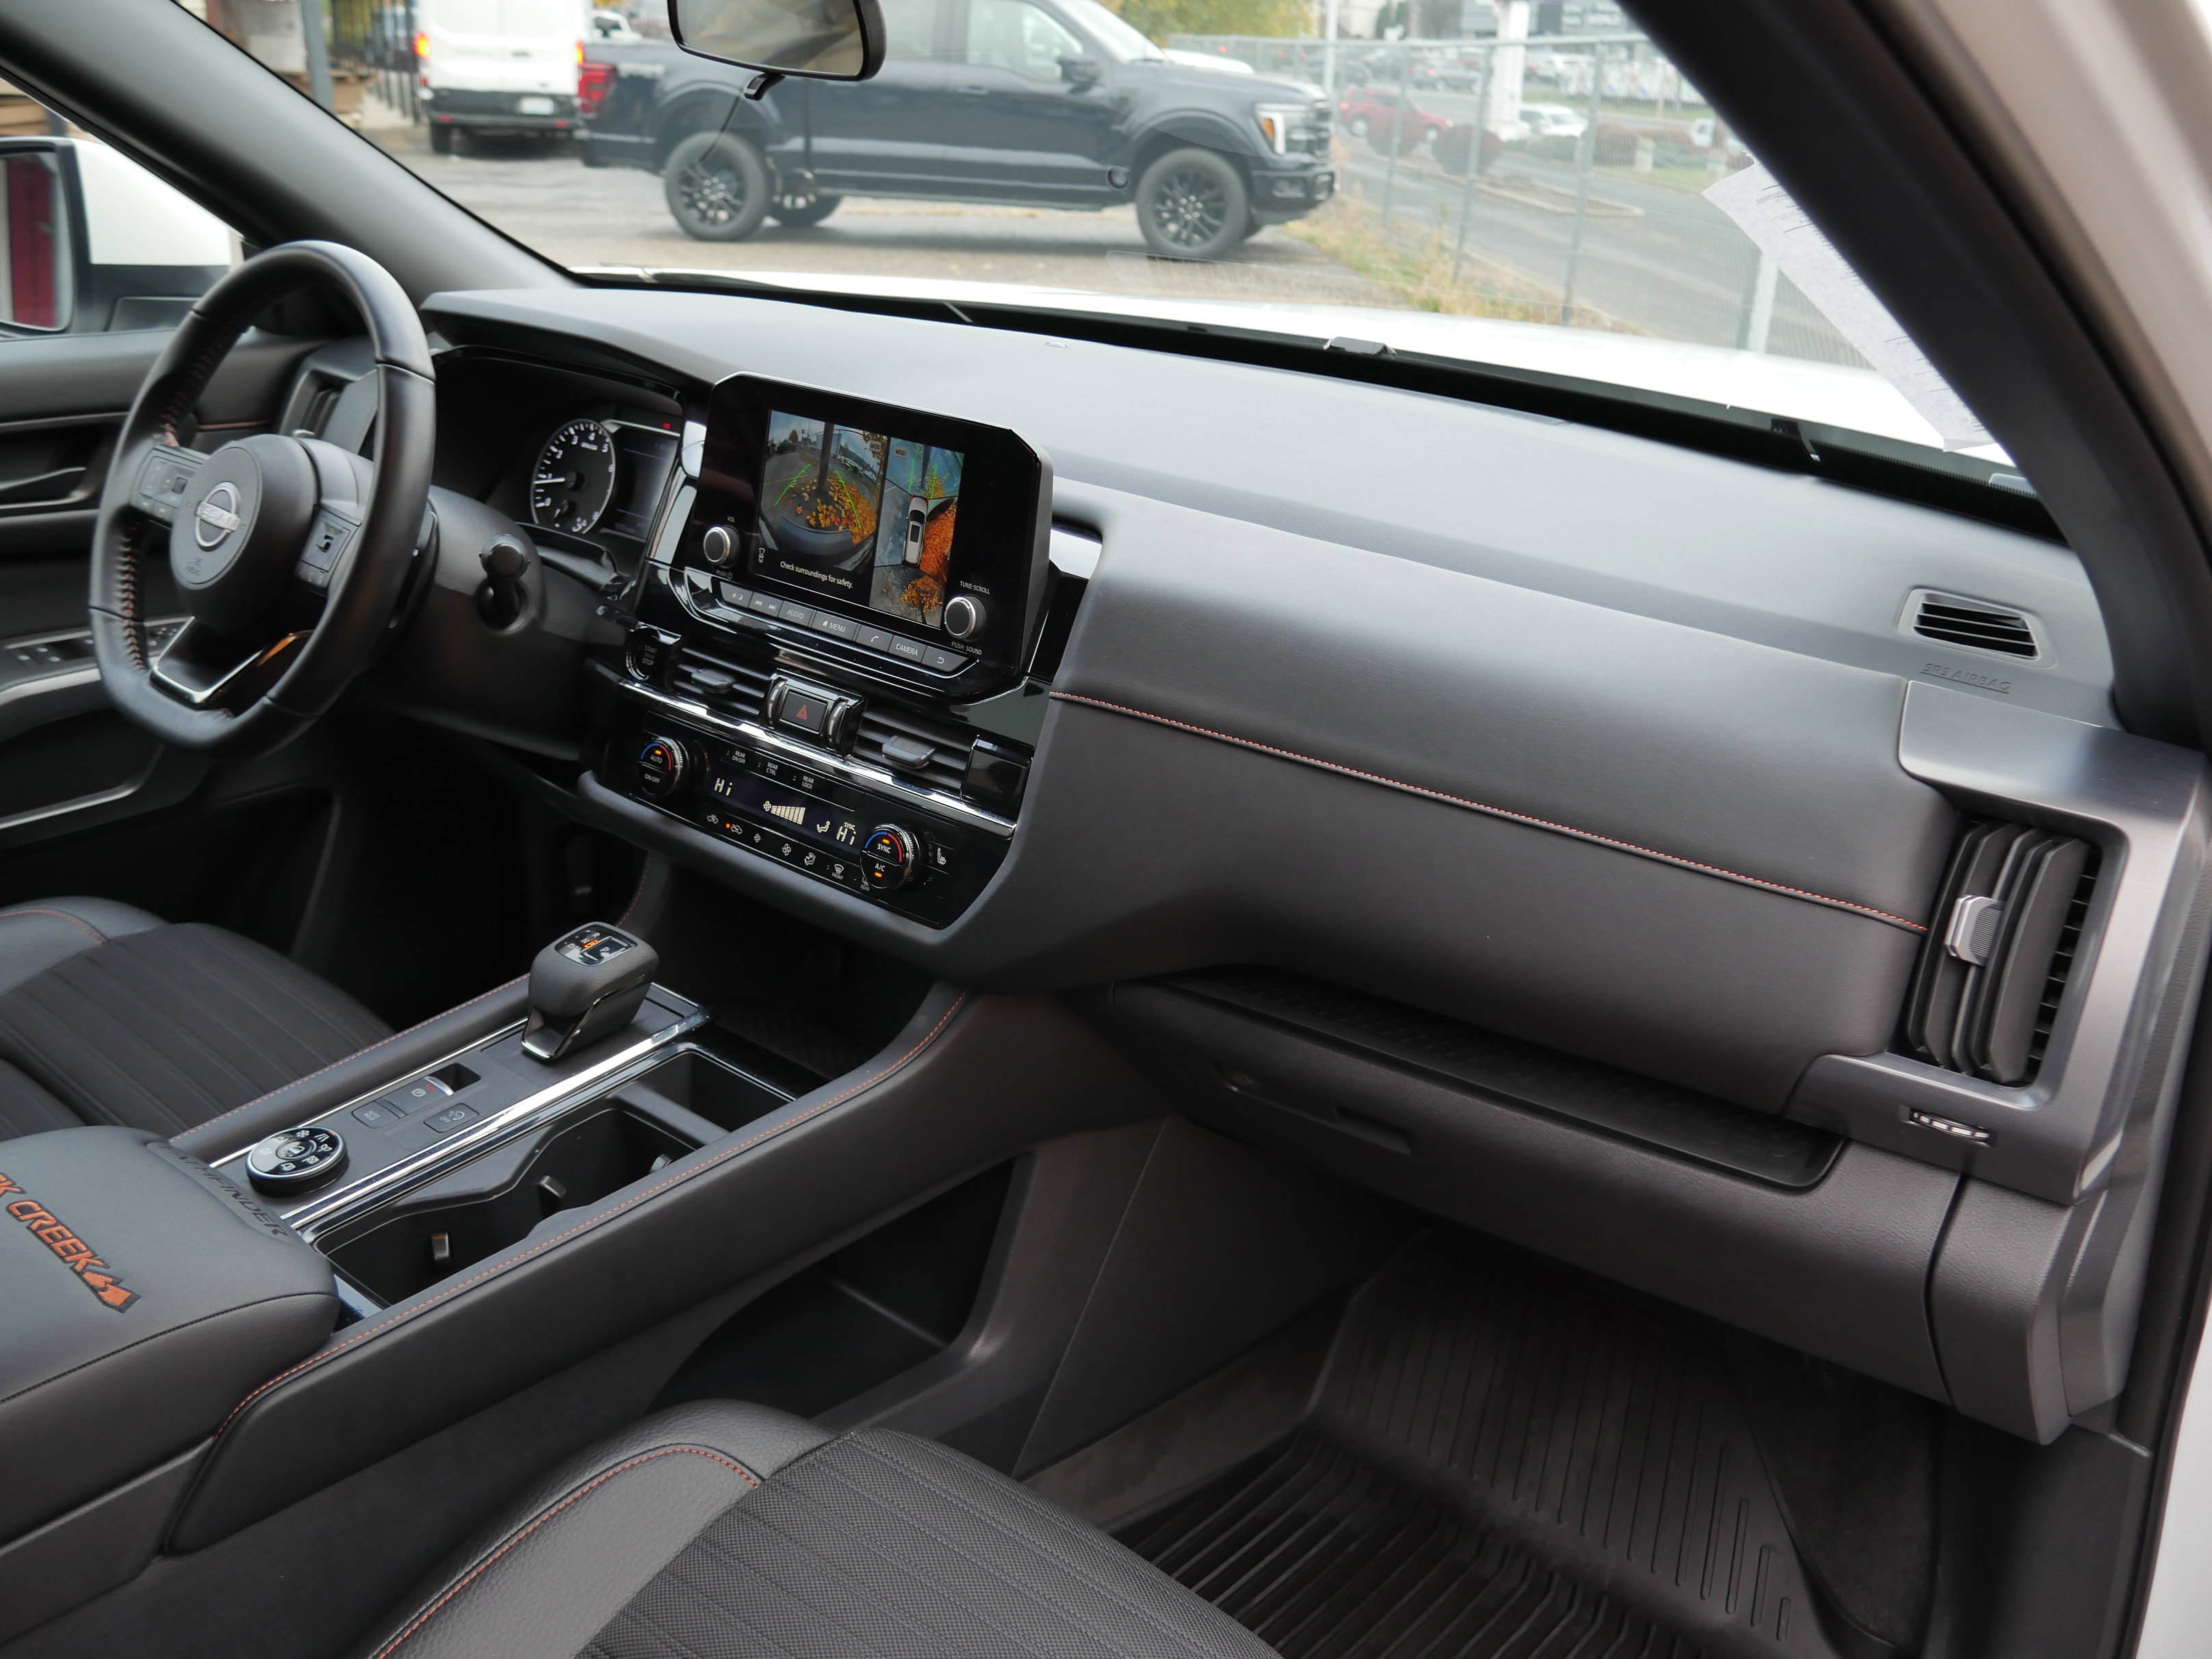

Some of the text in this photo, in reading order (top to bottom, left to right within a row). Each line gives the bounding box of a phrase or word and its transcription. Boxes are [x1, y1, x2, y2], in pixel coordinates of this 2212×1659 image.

[780, 561, 853, 589] Check surroundings for safety.
[786, 608, 804, 619] AUDIO
[829, 622, 847, 632] MENU
[896, 643, 918, 656] CAMERA
[951, 641, 982, 655] PUSH SOUND
[1922, 663, 2011, 691] SRS AIRBAG
[734, 750, 746, 758] REAR
[766, 767, 776, 775] CTRL
[767, 762, 778, 770] REAR
[802, 775, 814, 784] REAR
[714, 777, 732, 796] Hi
[801, 781, 813, 790] LOCK
[844, 822, 856, 831] SYNC
[836, 826, 856, 845] Hi
[877, 843, 892, 854] SYNC
[875, 863, 886, 872] A/C
[6, 1200, 110, 1273] CREEK
